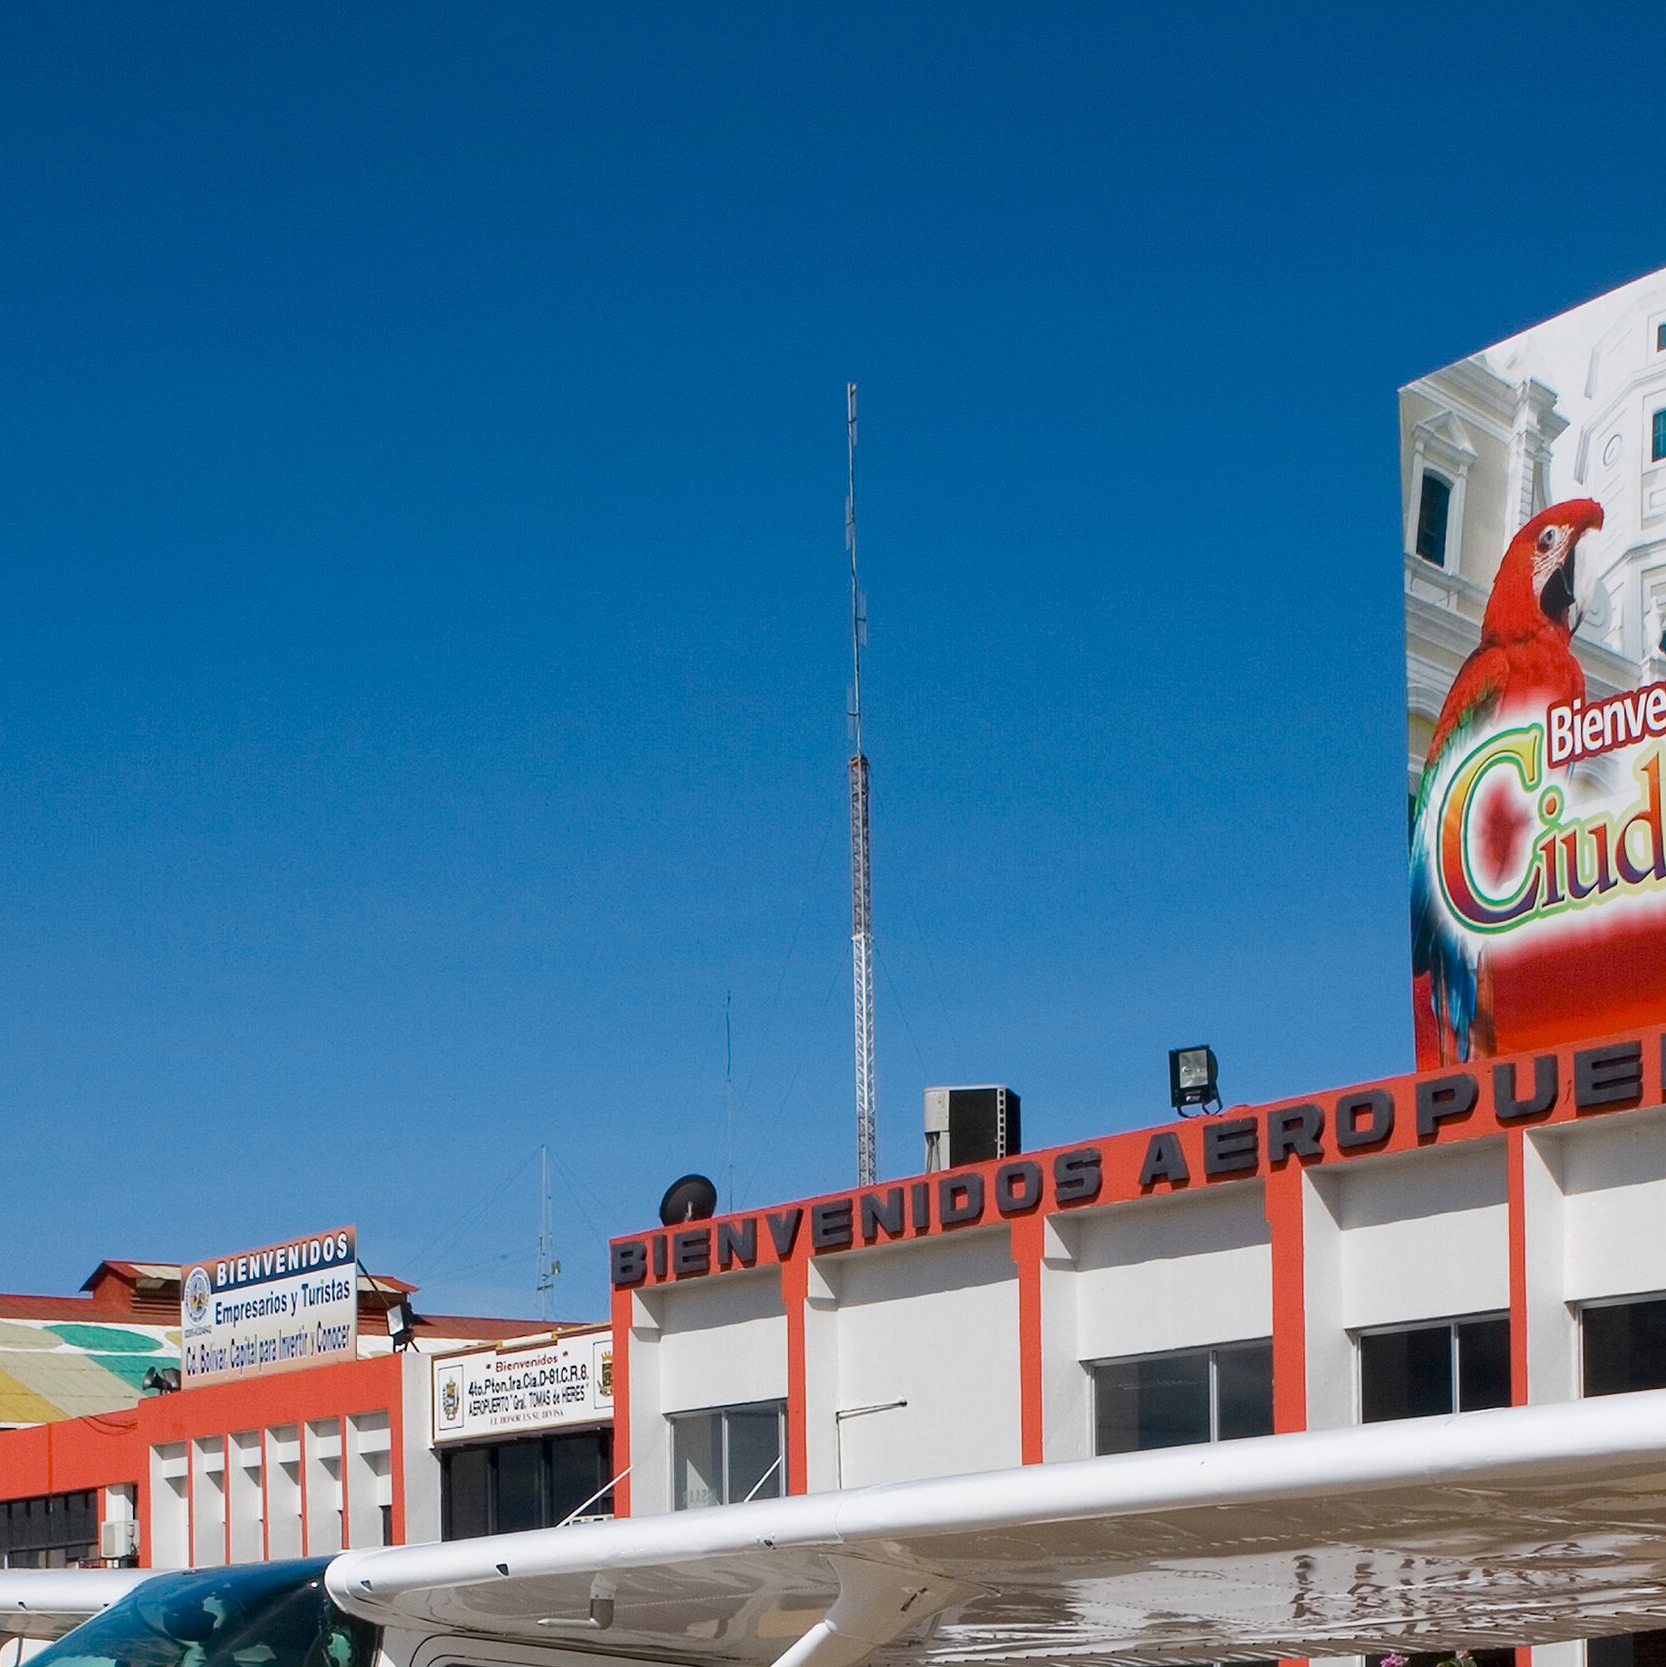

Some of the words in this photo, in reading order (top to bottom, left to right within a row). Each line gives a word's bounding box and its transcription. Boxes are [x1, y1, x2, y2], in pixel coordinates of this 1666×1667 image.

[610, 1145, 1104, 1288] BIENVENIDOS
[217, 1232, 348, 1287] BIENVENIDOS
[215, 1291, 287, 1328] Empresarios
[291, 1291, 298, 1317] y
[301, 1279, 350, 1308] Turistas
[230, 1334, 257, 1375] Capital
[259, 1338, 276, 1373] para
[278, 1325, 308, 1360] Invertir
[309, 1331, 316, 1356] y
[316, 1321, 351, 1353] Conocer
[495, 1354, 558, 1373] Bienvenidos
[468, 1396, 509, 1417] AEROPUERTO
[529, 1390, 551, 1408] TOMAS
[552, 1389, 560, 1405] de
